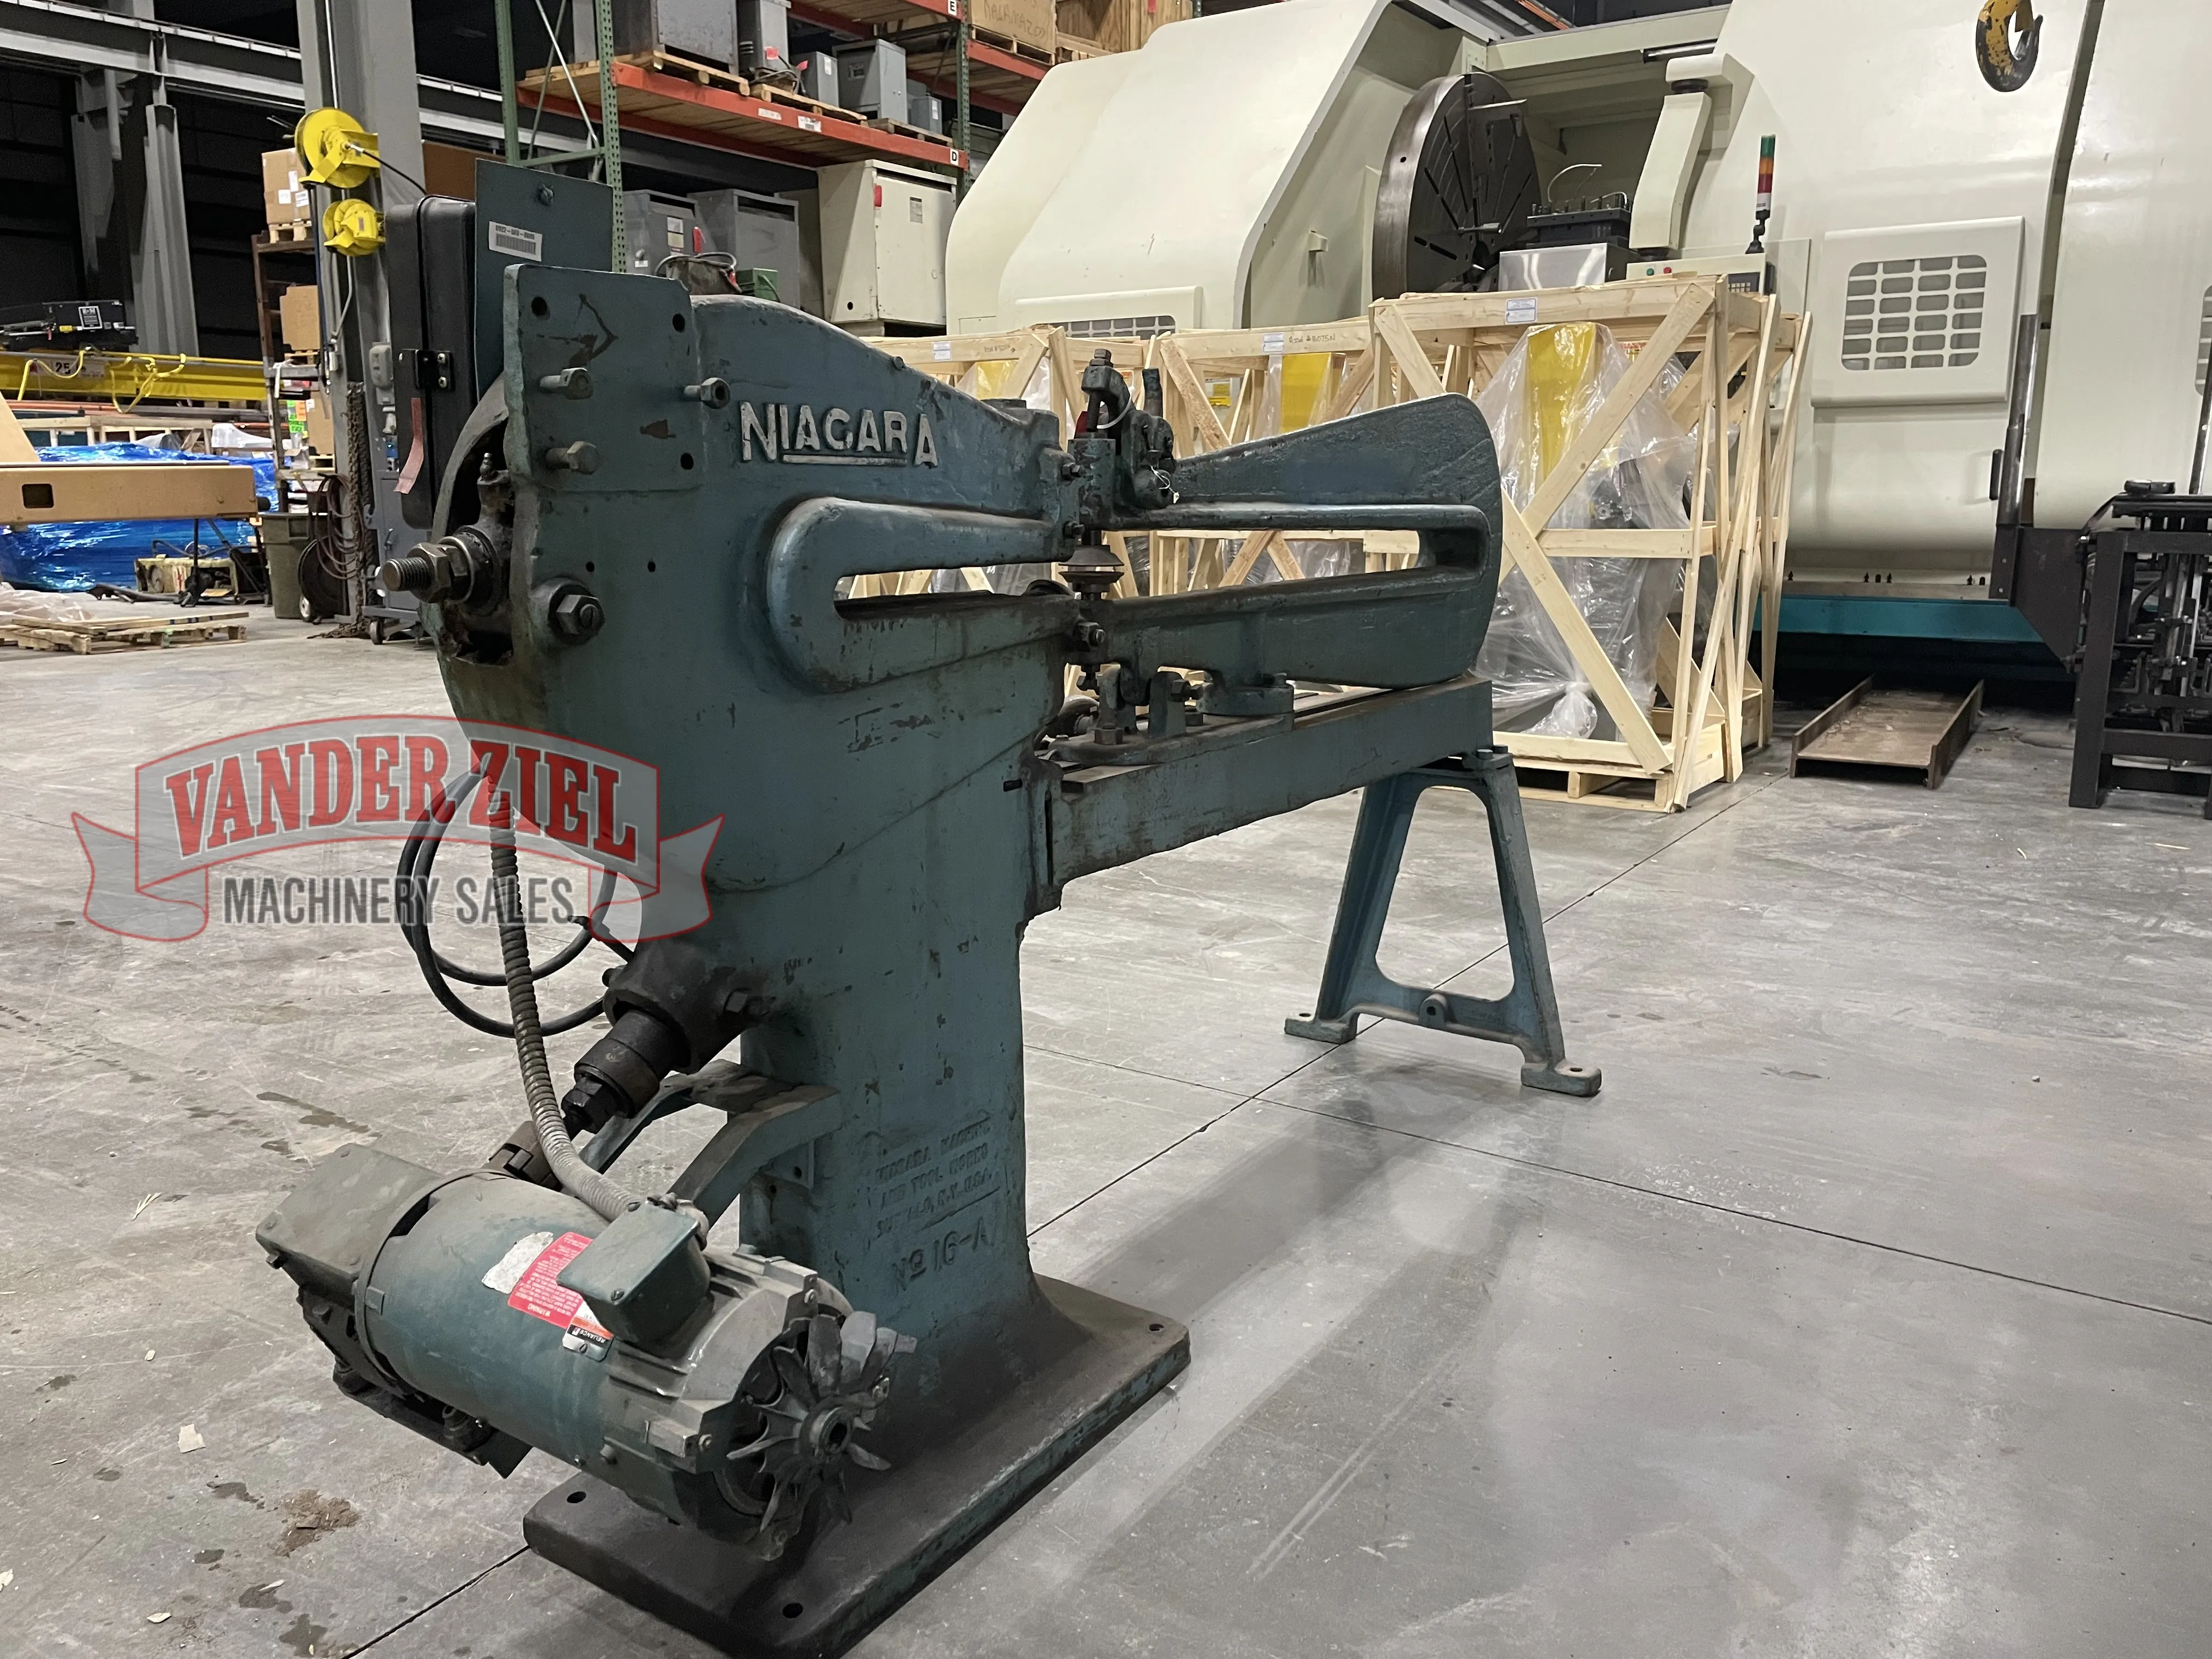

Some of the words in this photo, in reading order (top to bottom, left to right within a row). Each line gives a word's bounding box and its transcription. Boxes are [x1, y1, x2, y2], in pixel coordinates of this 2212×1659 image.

[950, 1, 955, 12] E
[952, 151, 957, 161] D
[55, 362, 71, 375] 25
[740, 401, 939, 467] NIAGARA
[579, 1329, 606, 1344] RELIANCE
